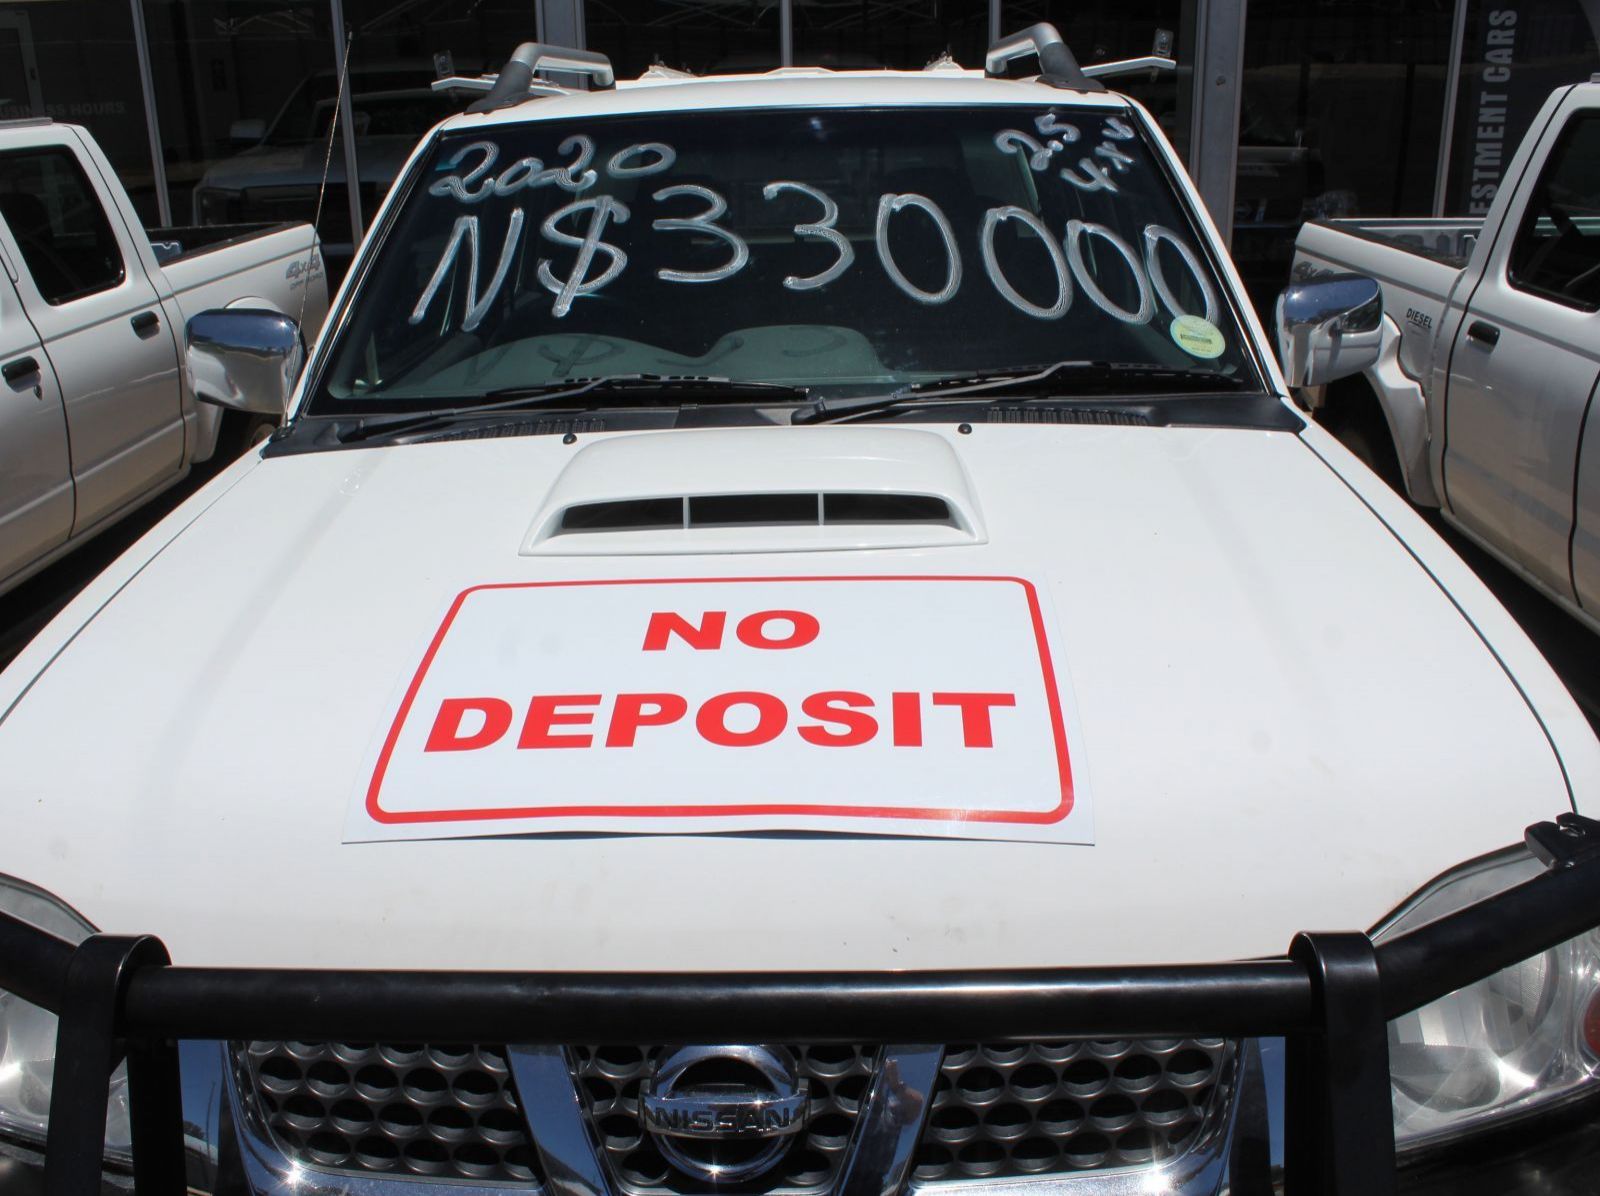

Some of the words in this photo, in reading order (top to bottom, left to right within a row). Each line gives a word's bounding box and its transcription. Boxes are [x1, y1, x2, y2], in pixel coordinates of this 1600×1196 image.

[1483, 9, 1518, 83] CARS
[70, 102, 127, 115] HOURS
[429, 135, 677, 201] 2020
[1406, 308, 1433, 329] DIESEL
[642, 609, 821, 652] NO
[423, 690, 1017, 753] DEPOSIT
[655, 1106, 791, 1132] NISSAN
